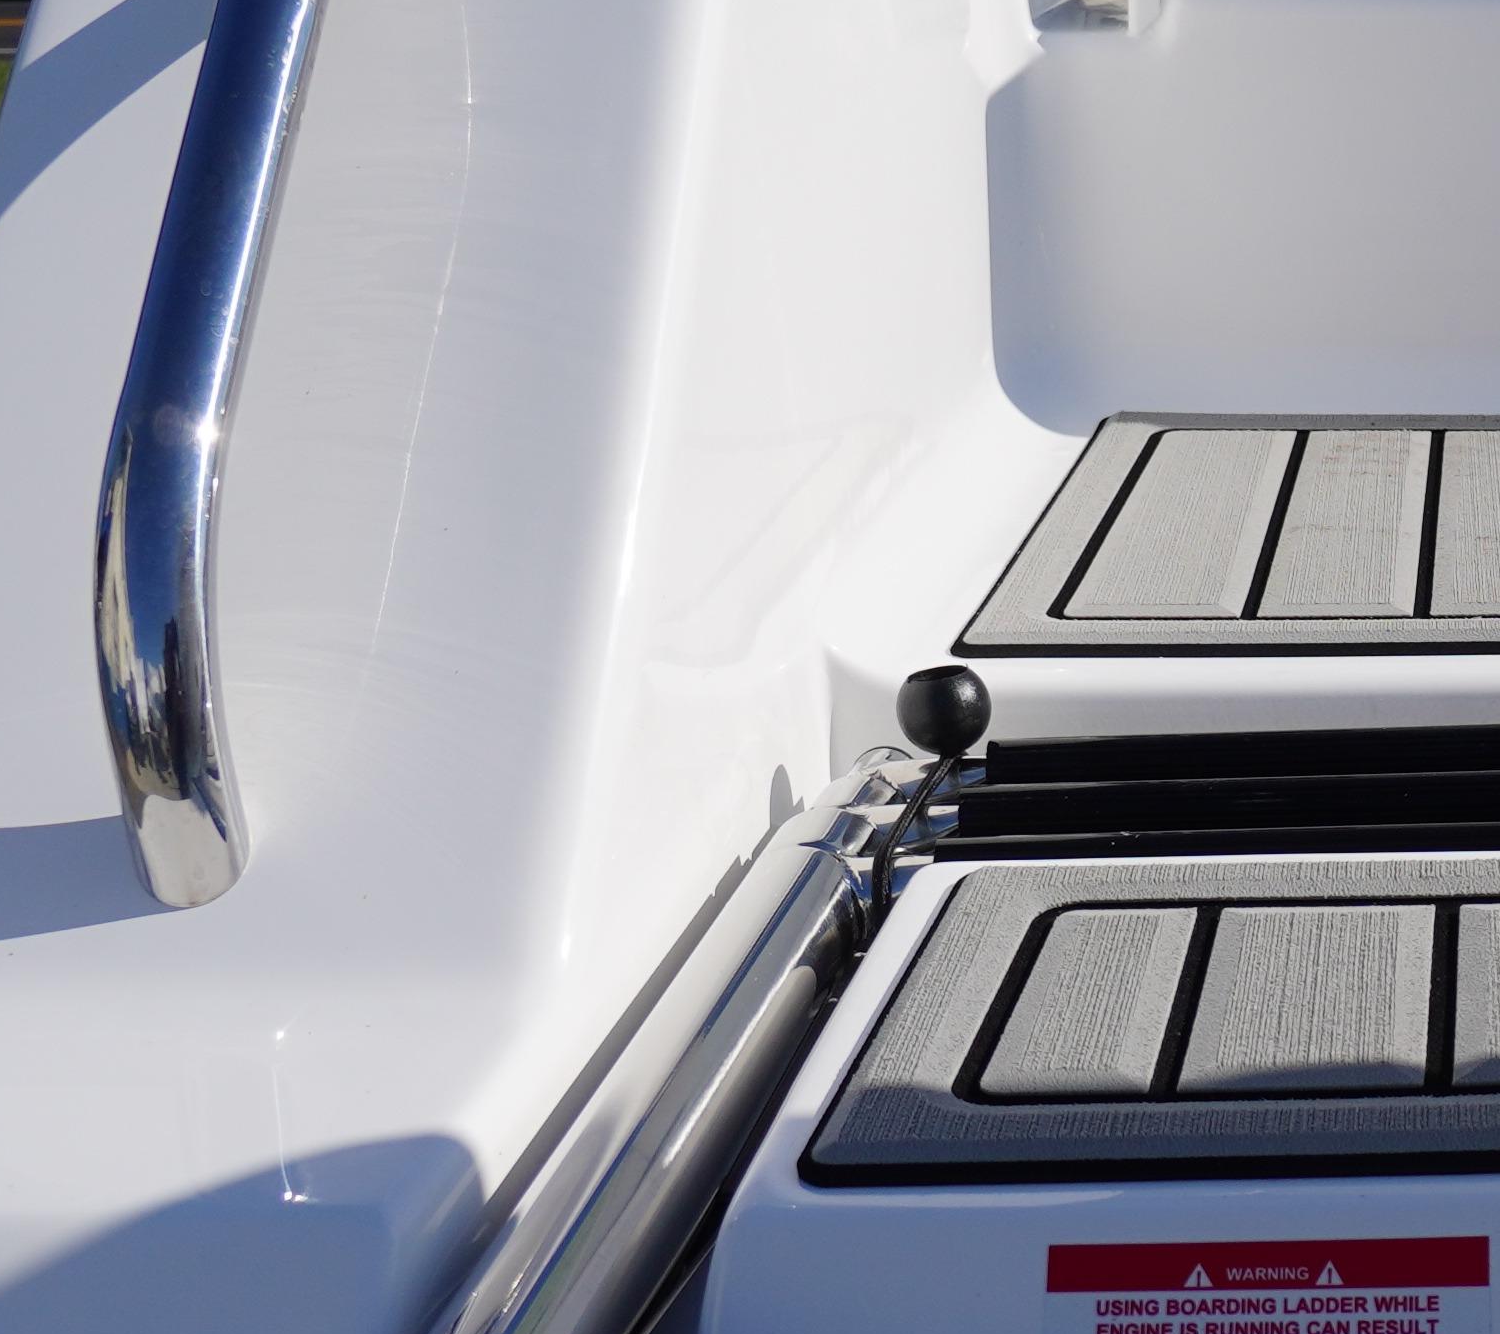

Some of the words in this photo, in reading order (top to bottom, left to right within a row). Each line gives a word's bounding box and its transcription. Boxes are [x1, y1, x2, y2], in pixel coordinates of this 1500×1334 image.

[1226, 1267, 1309, 1282] WARNING
[1096, 1299, 1160, 1316] USING
[1166, 1298, 1277, 1316] BOARDING
[1283, 1296, 1369, 1314] LADDER
[1373, 1295, 1440, 1313] WHILE
